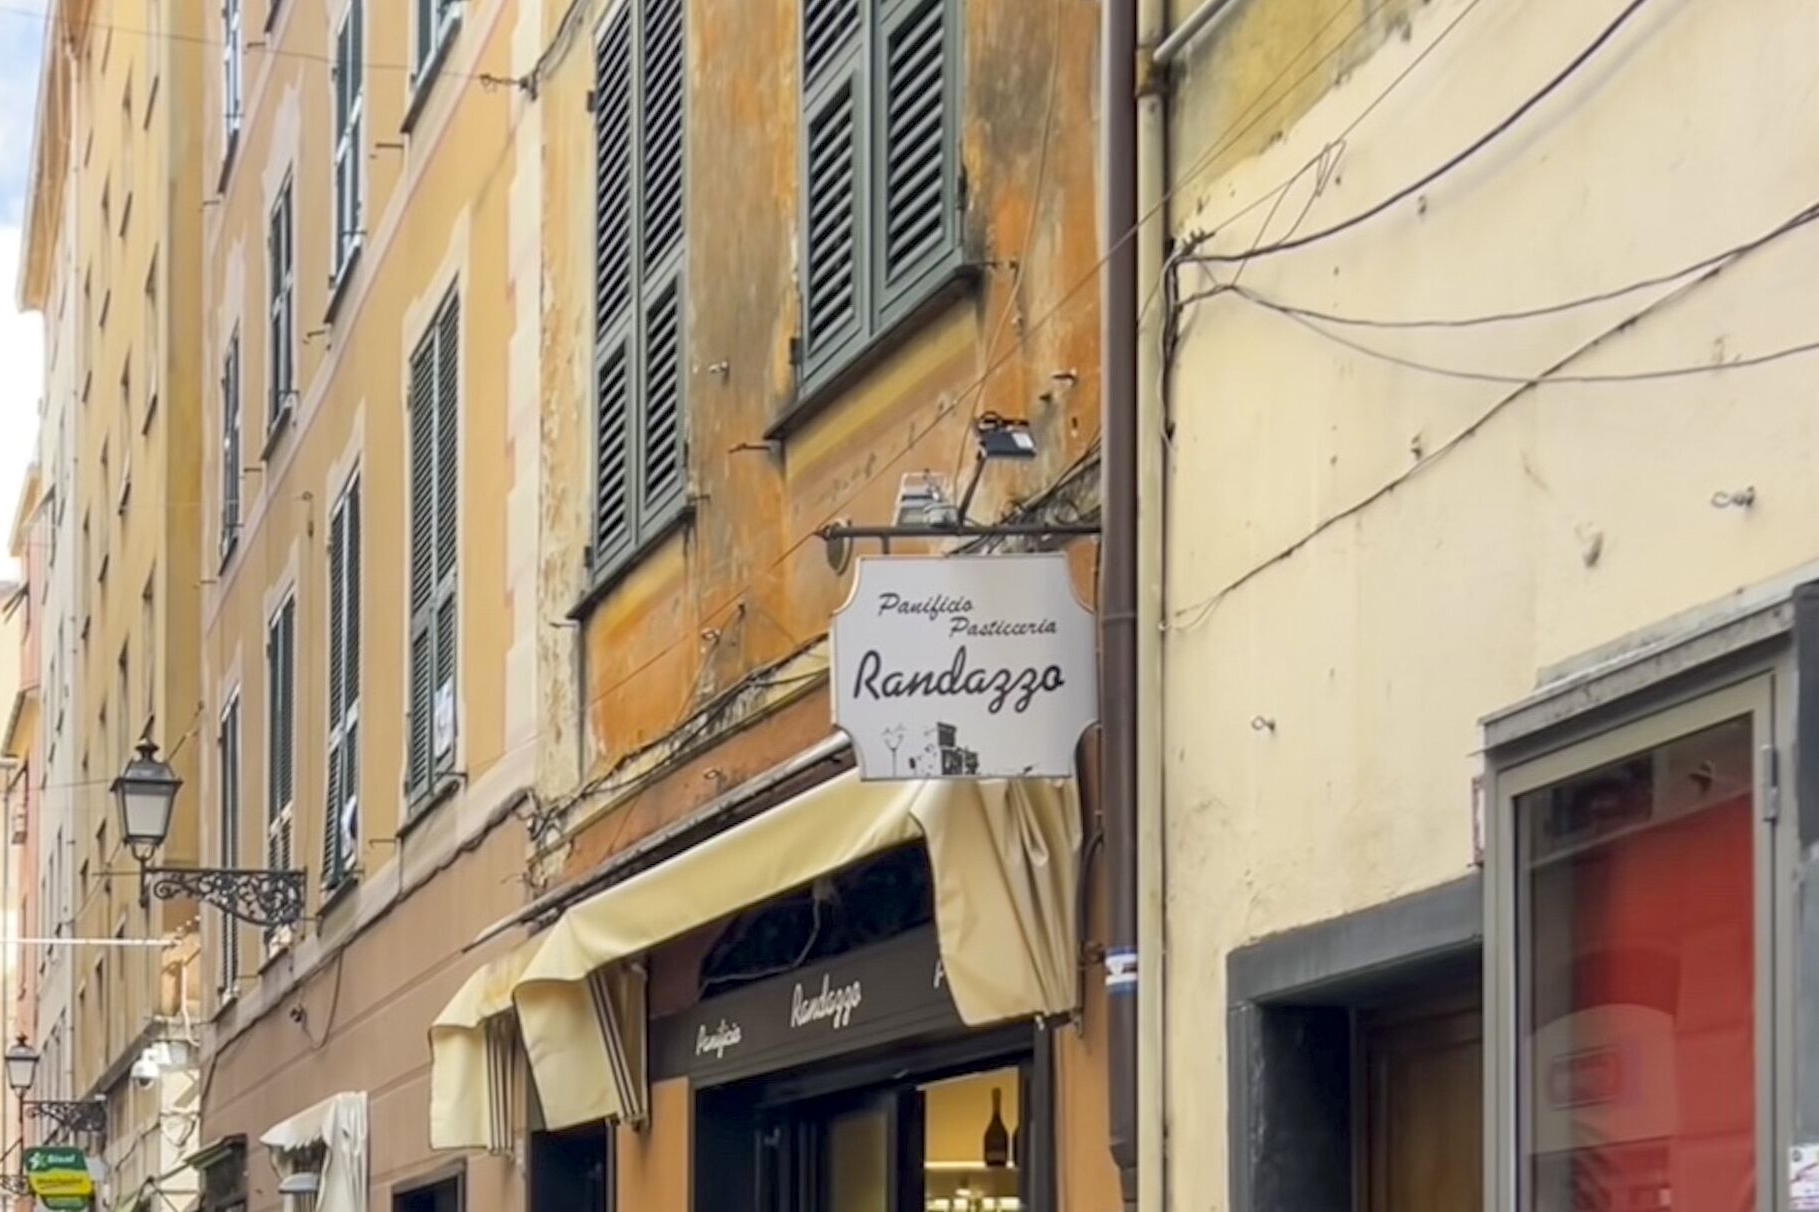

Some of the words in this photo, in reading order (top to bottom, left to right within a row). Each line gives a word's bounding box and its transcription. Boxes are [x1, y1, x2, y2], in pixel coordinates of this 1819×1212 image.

[878, 592, 974, 621] Panificio
[949, 616, 1057, 638] Pasticceria
[853, 645, 1065, 715] Randazzo
[790, 973, 862, 1029] Randazzo
